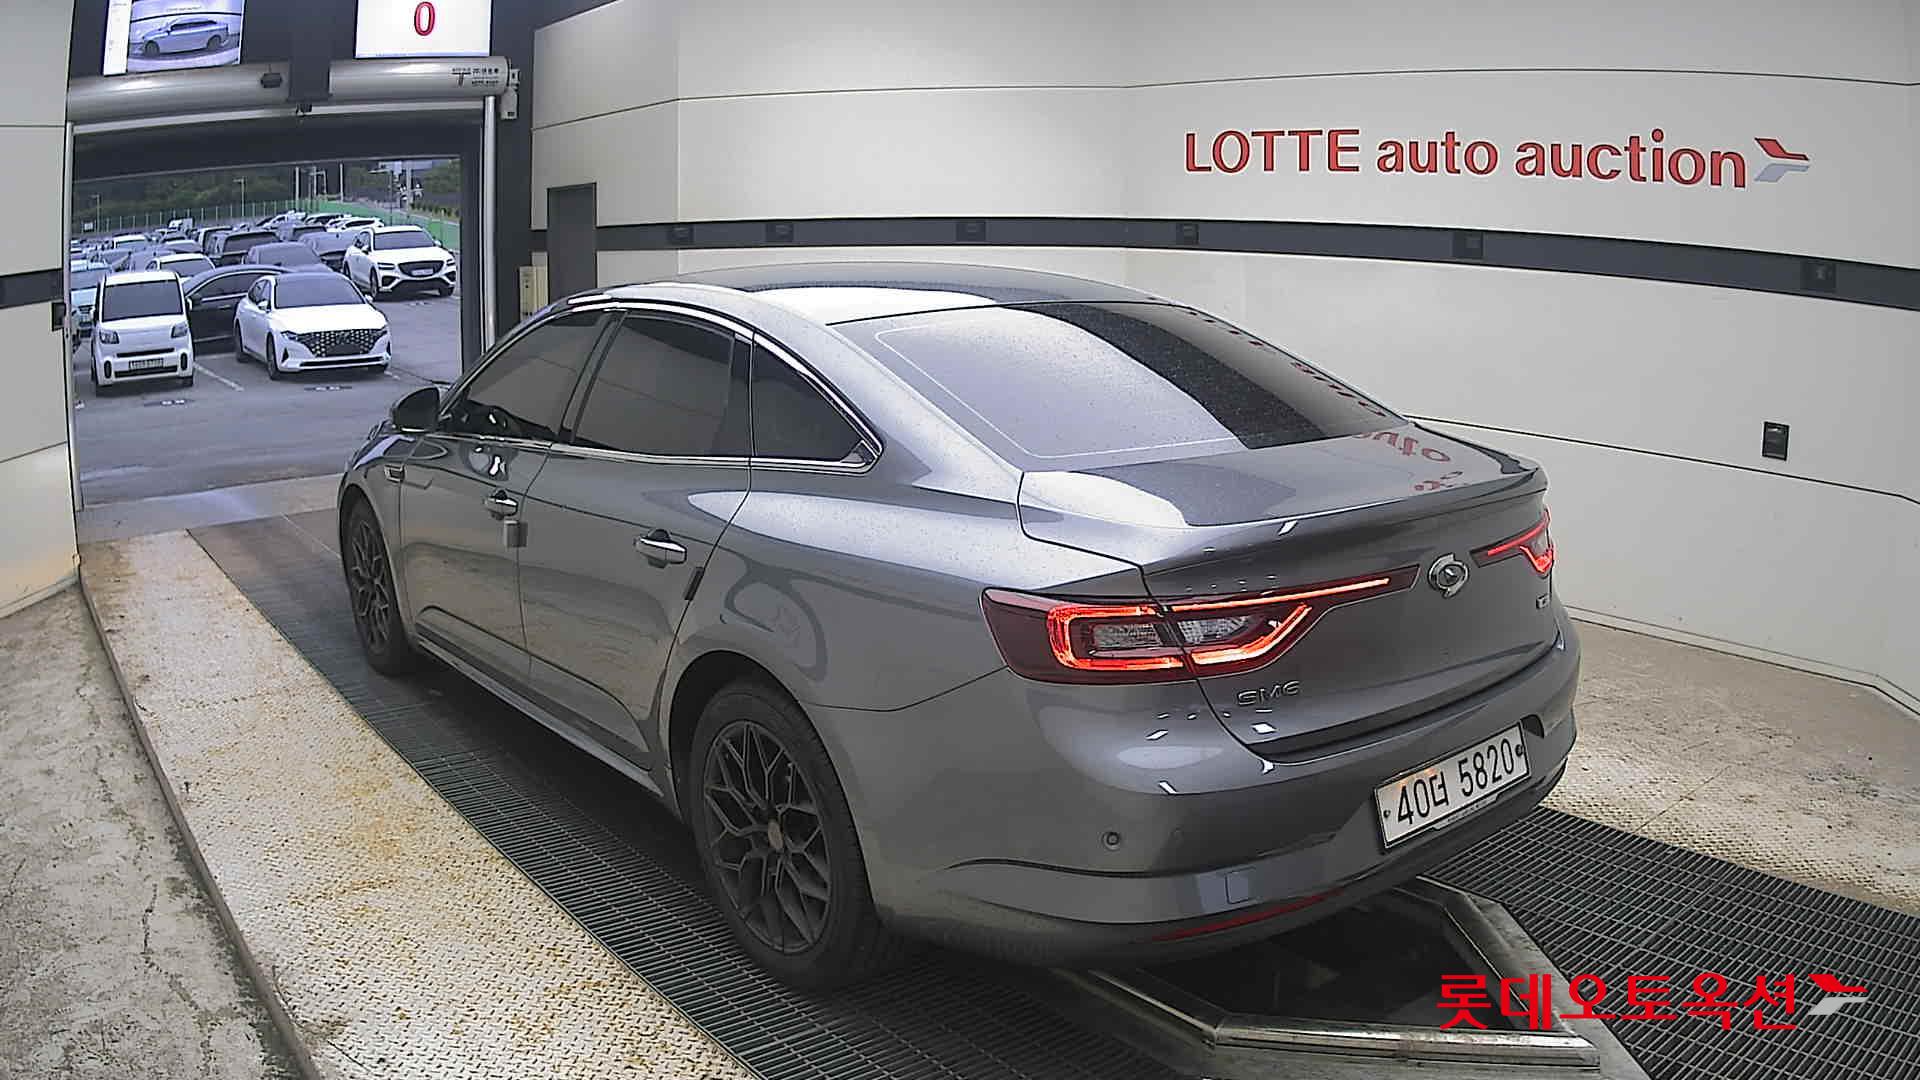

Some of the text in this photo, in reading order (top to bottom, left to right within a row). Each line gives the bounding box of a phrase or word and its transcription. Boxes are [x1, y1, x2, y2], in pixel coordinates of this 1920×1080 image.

[414, 1, 436, 36] 0
[1186, 129, 1747, 188] LOTTE auto auction
[1237, 679, 1301, 706] SM6
[1397, 738, 1514, 825] 40더 5820
